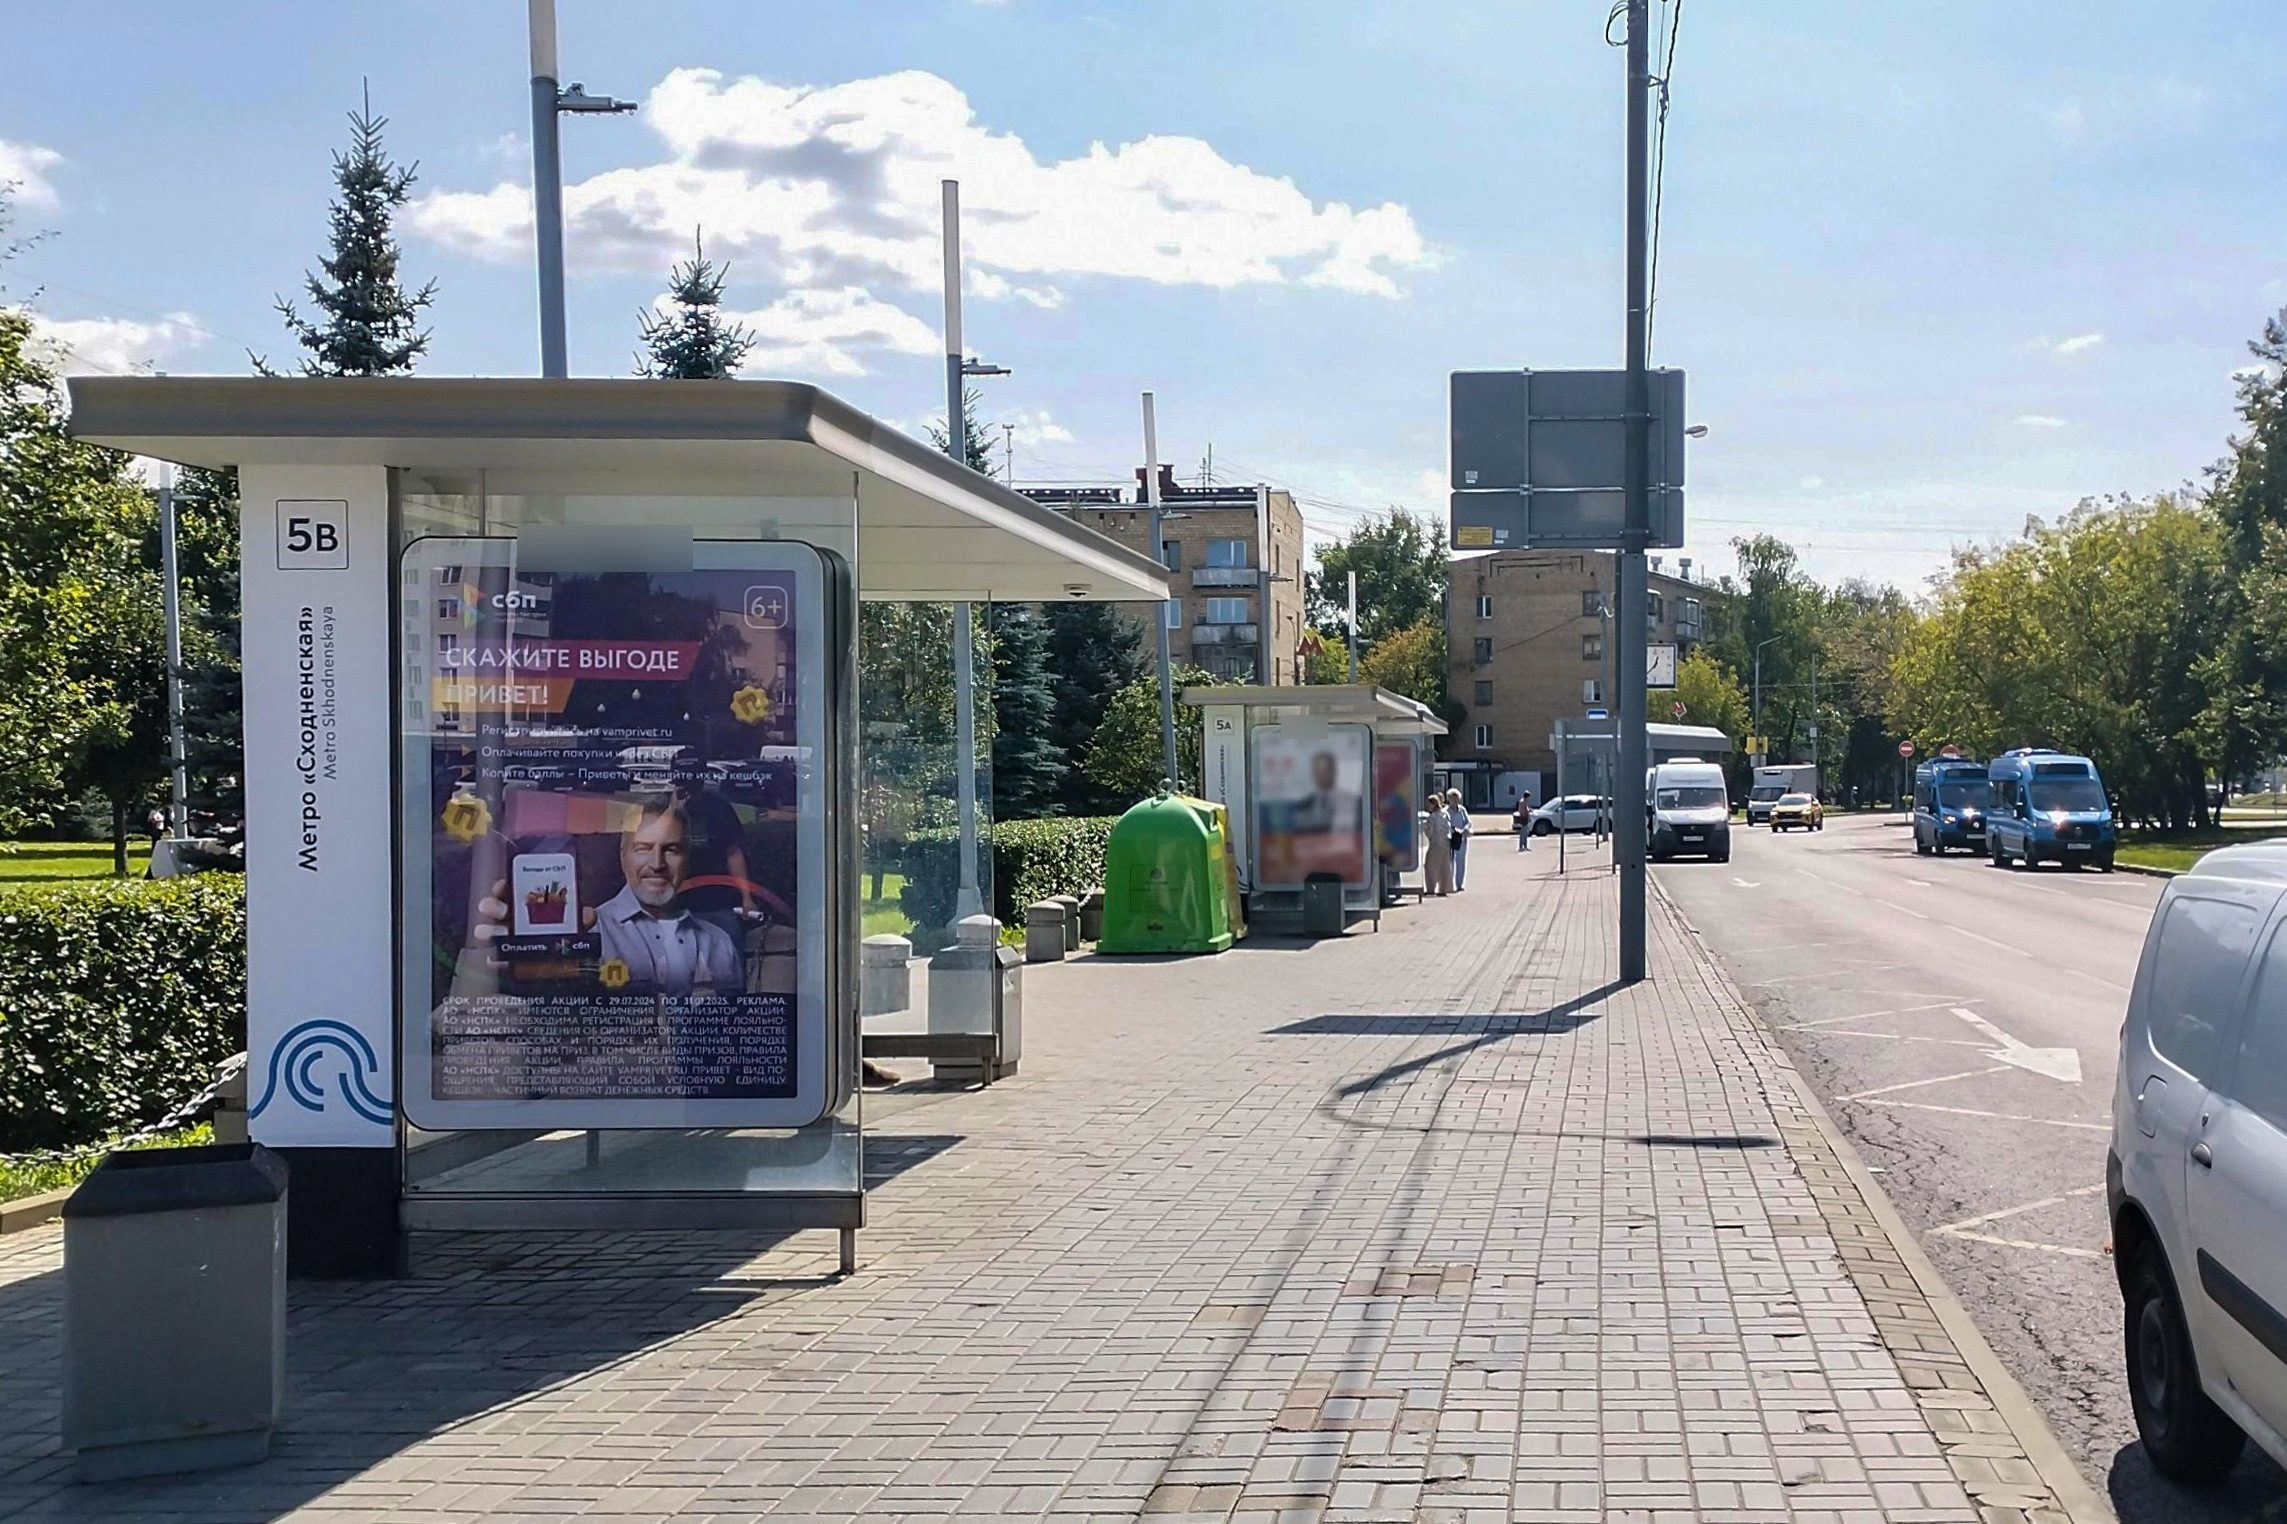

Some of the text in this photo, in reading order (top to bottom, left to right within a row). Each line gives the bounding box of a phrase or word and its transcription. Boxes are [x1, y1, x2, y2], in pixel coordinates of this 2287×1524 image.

[287, 518, 338, 552] 5В
[750, 596, 782, 617] 6+
[445, 648, 679, 672] СКАЖИТЕ ВЫГОДЕ
[320, 606, 337, 780] Metro Skhodnenskaya
[445, 685, 548, 704] ПРИВЕТ!
[602, 725, 673, 739] vamprivet.ru
[296, 606, 321, 872] Метро «Сходненская»
[482, 746, 560, 758] Оплачивайте
[562, 750, 613, 760] покупки
[482, 767, 525, 780] Копите
[527, 767, 565, 780] баллы
[578, 768, 630, 780] Приветы
[644, 769, 693, 780] меняйте
[695, 771, 710, 780] их
[729, 769, 773, 780] кешбэк
[501, 943, 548, 952] Оплатить
[443, 996, 470, 1005] СРОК
[477, 996, 545, 1005] ПРОВЕДЕНИЯ
[551, 996, 590, 1006] АКЦИИ
[595, 996, 603, 1005] С
[661, 996, 678, 1005] ПО
[442, 1006, 459, 1015] АО
[665, 1006, 738, 1015] ОРГАНИЗАТОР
[442, 1016, 459, 1025] АО
[582, 1016, 654, 1025] РЕГИСТРАЦИЯ
[668, 1016, 729, 1025] ПРОГРАММЕ
[465, 1026, 481, 1035] АО
[723, 1026, 787, 1035] КОЛИЧЕСТВЕ
[740, 1036, 787, 1045] ПОРЯДКЕ
[739, 1046, 787, 1055] ПРАВИЛА
[717, 1056, 788, 1065] ЛОЯЛЬНОСТИ
[442, 1066, 459, 1075] АО
